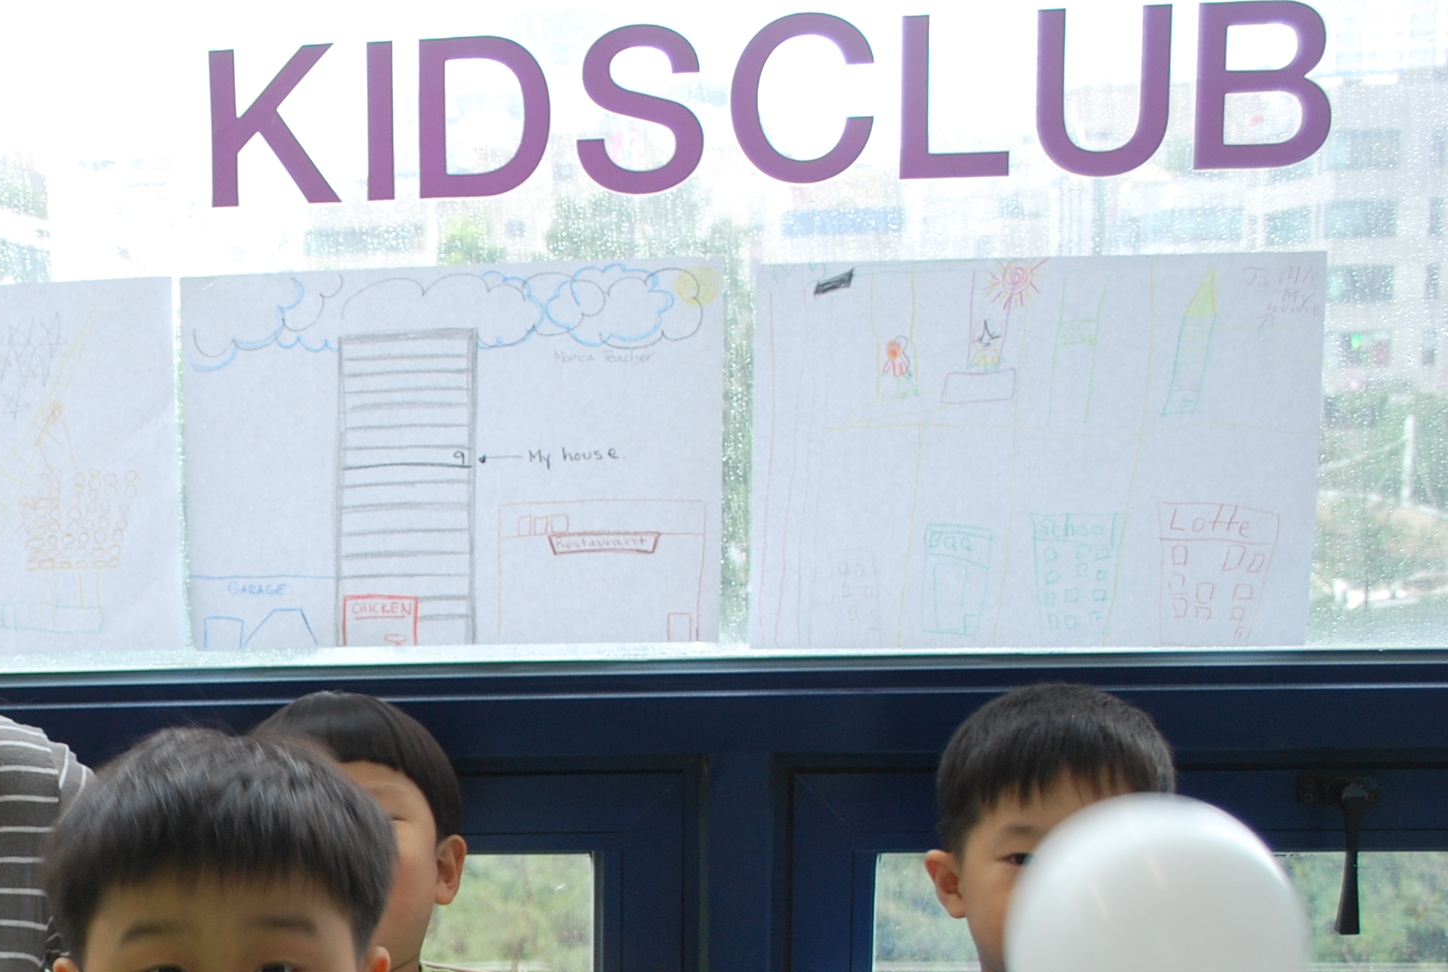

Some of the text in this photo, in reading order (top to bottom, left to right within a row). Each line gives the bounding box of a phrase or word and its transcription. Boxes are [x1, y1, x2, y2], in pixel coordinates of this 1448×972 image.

[208, 0, 1332, 207] KIDSCLUB
[452, 449, 465, 466] 9
[528, 446, 628, 470] My house.
[1169, 503, 1250, 539] Lotte
[351, 601, 413, 617] CHICKEN
